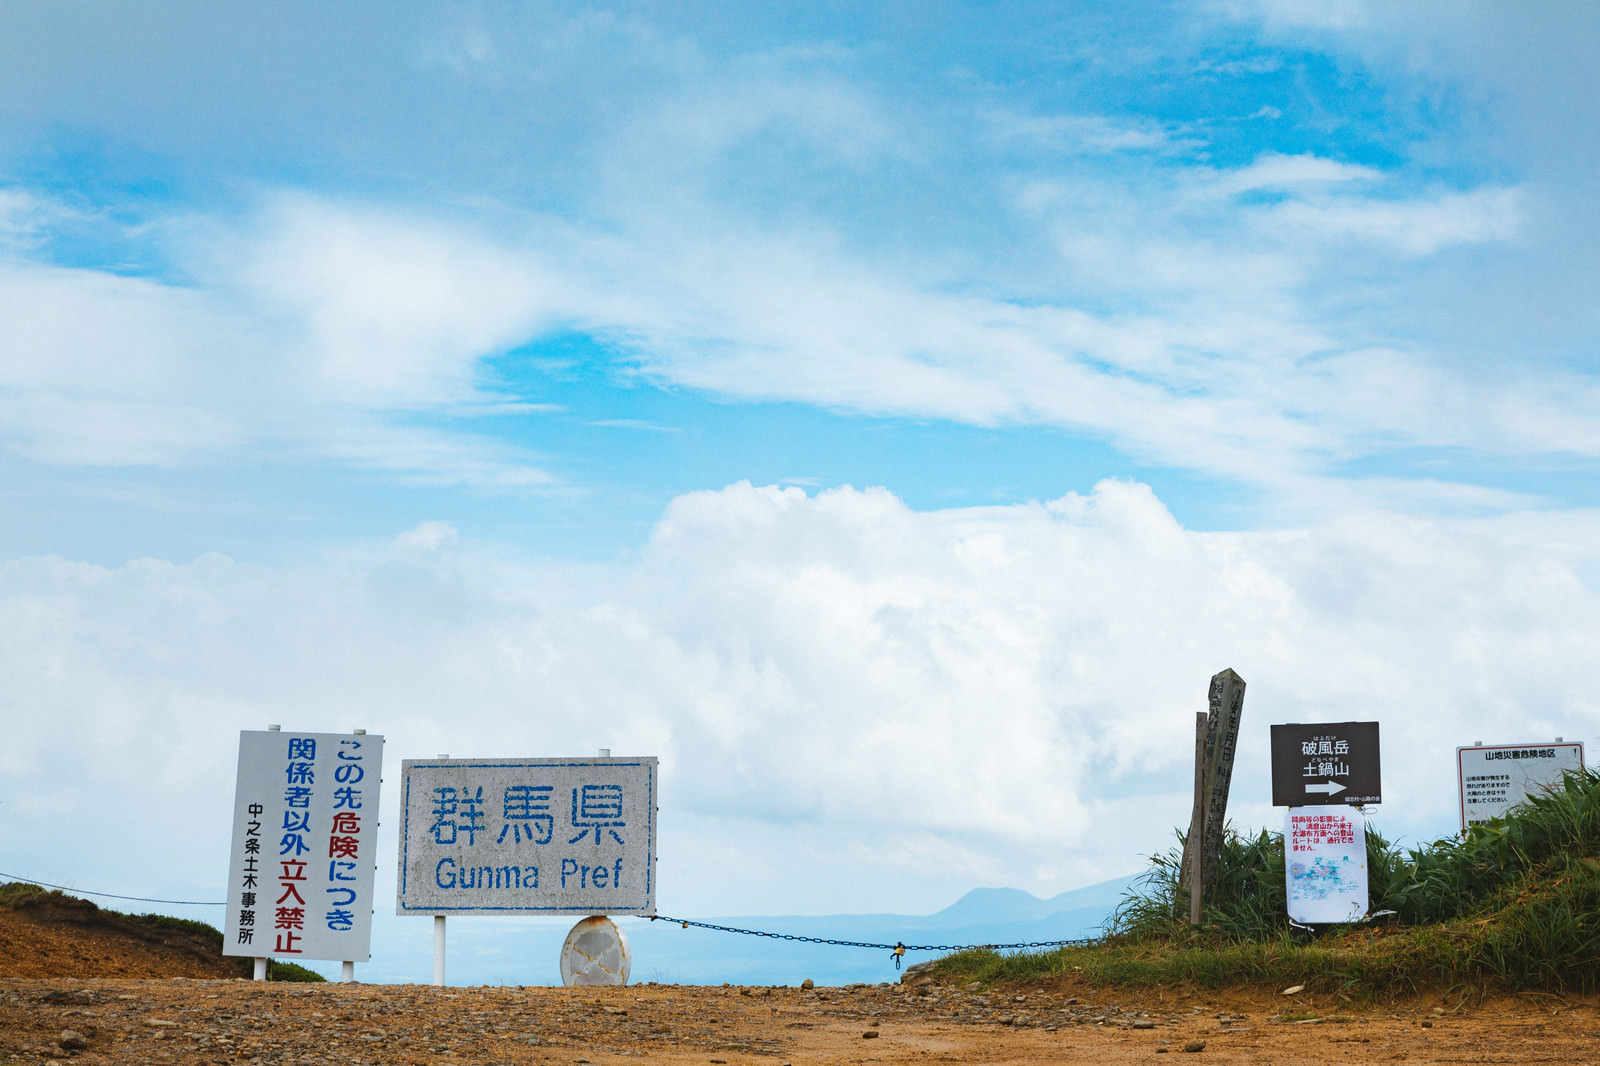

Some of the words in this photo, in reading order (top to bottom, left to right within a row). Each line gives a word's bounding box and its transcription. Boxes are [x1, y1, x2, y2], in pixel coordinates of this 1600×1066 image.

[1301, 740, 1350, 756] 破風岳
[1302, 762, 1350, 777] 土鍋山
[1485, 748, 1556, 761] 山地災害危険地区
[325, 739, 365, 931] この先危険につき
[429, 784, 626, 846] 群馬県
[273, 737, 317, 954] 関係者以外立入禁止
[237, 802, 264, 945] 中之条土木事務所
[435, 857, 540, 890] Gunma
[560, 857, 624, 889] Pref
